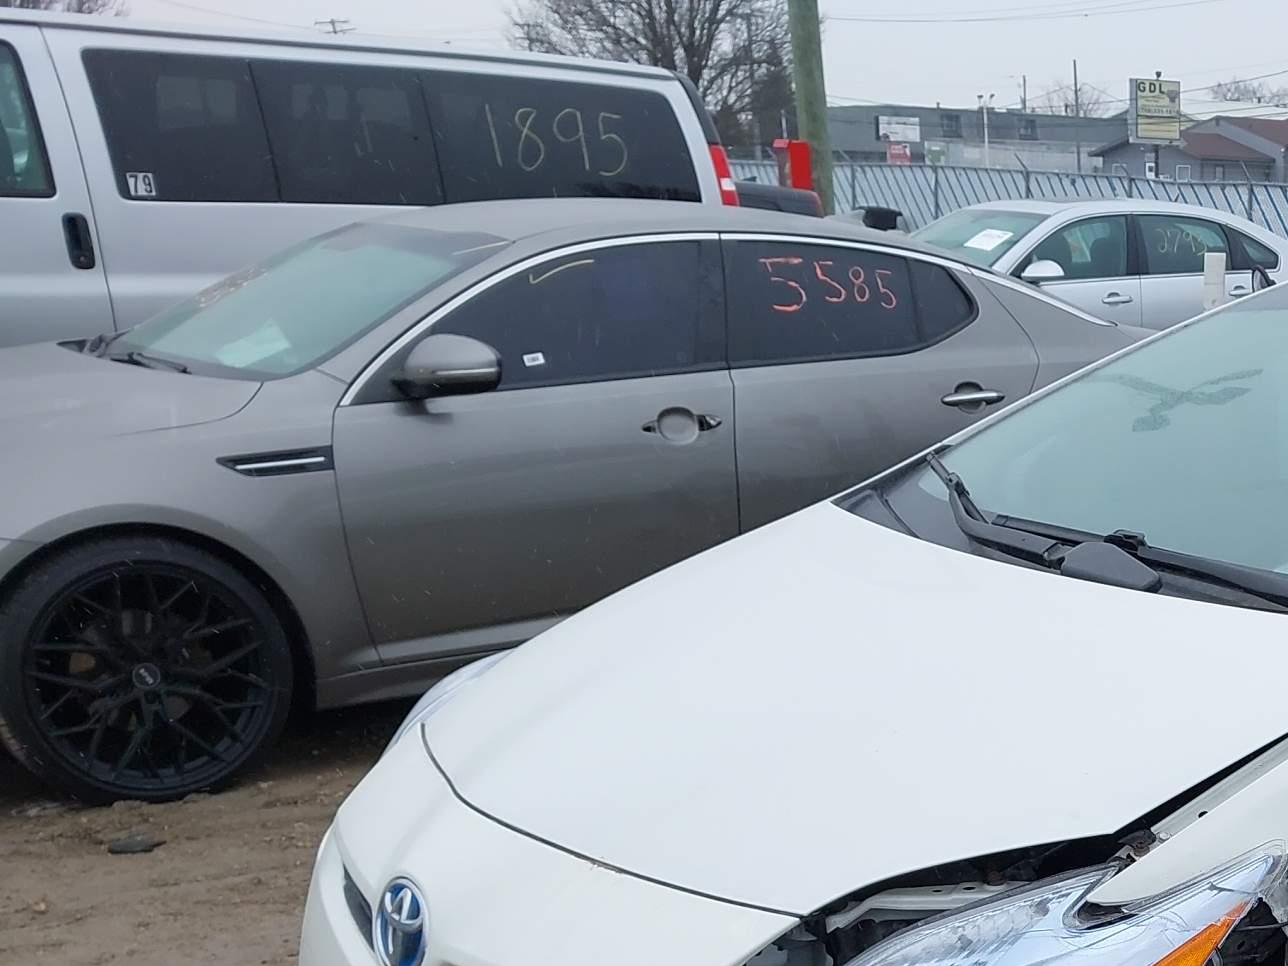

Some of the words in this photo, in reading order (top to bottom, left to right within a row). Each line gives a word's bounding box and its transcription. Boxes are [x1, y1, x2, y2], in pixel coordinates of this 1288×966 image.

[1137, 81, 1165, 94] GDL
[485, 103, 628, 176] 1895
[128, 174, 153, 194] 79
[758, 256, 898, 312] 5585
